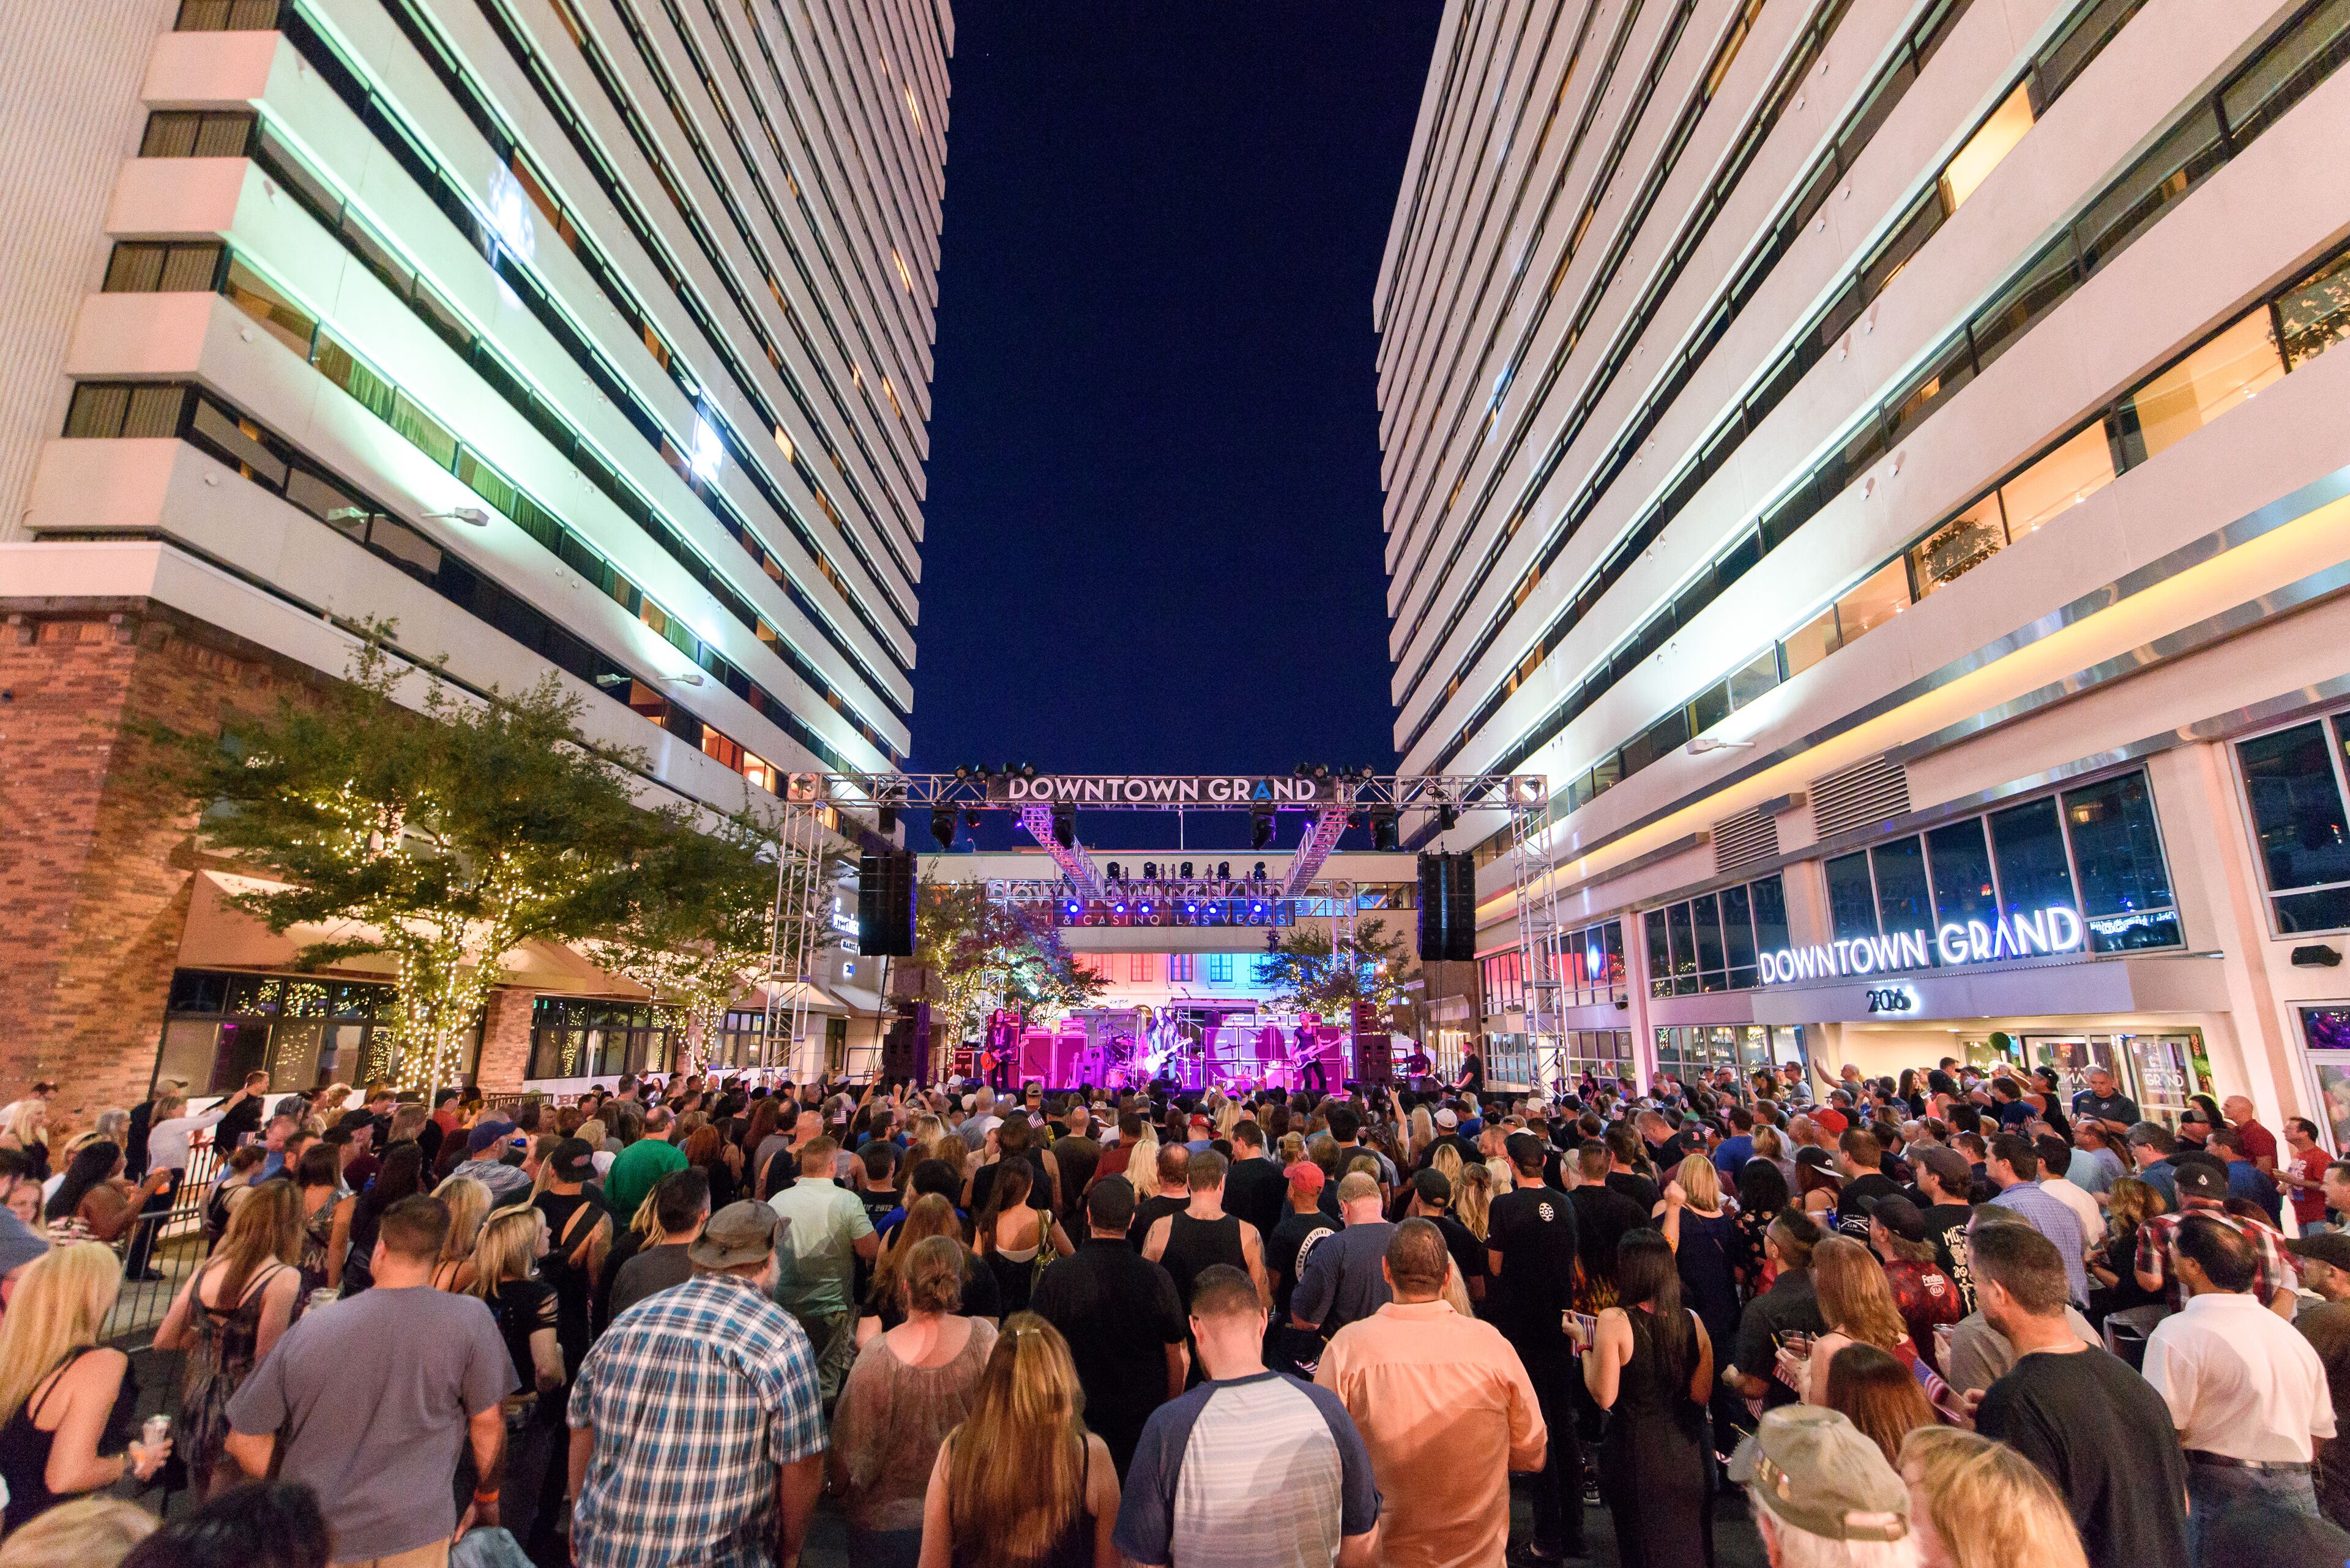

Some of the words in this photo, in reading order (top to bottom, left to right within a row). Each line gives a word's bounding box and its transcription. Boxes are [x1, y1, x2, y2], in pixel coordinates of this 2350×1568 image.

[1009, 778, 1198, 802] DOWNTOWN
[1207, 778, 1316, 802] GRAND
[1083, 914, 1160, 925] CASINO
[1176, 914, 1210, 925] LAS
[1222, 914, 1286, 925] VEGAS
[1759, 928, 1930, 984] DOWNTOWN
[1938, 906, 2085, 964] GRAND
[1865, 987, 1913, 1013] 206
